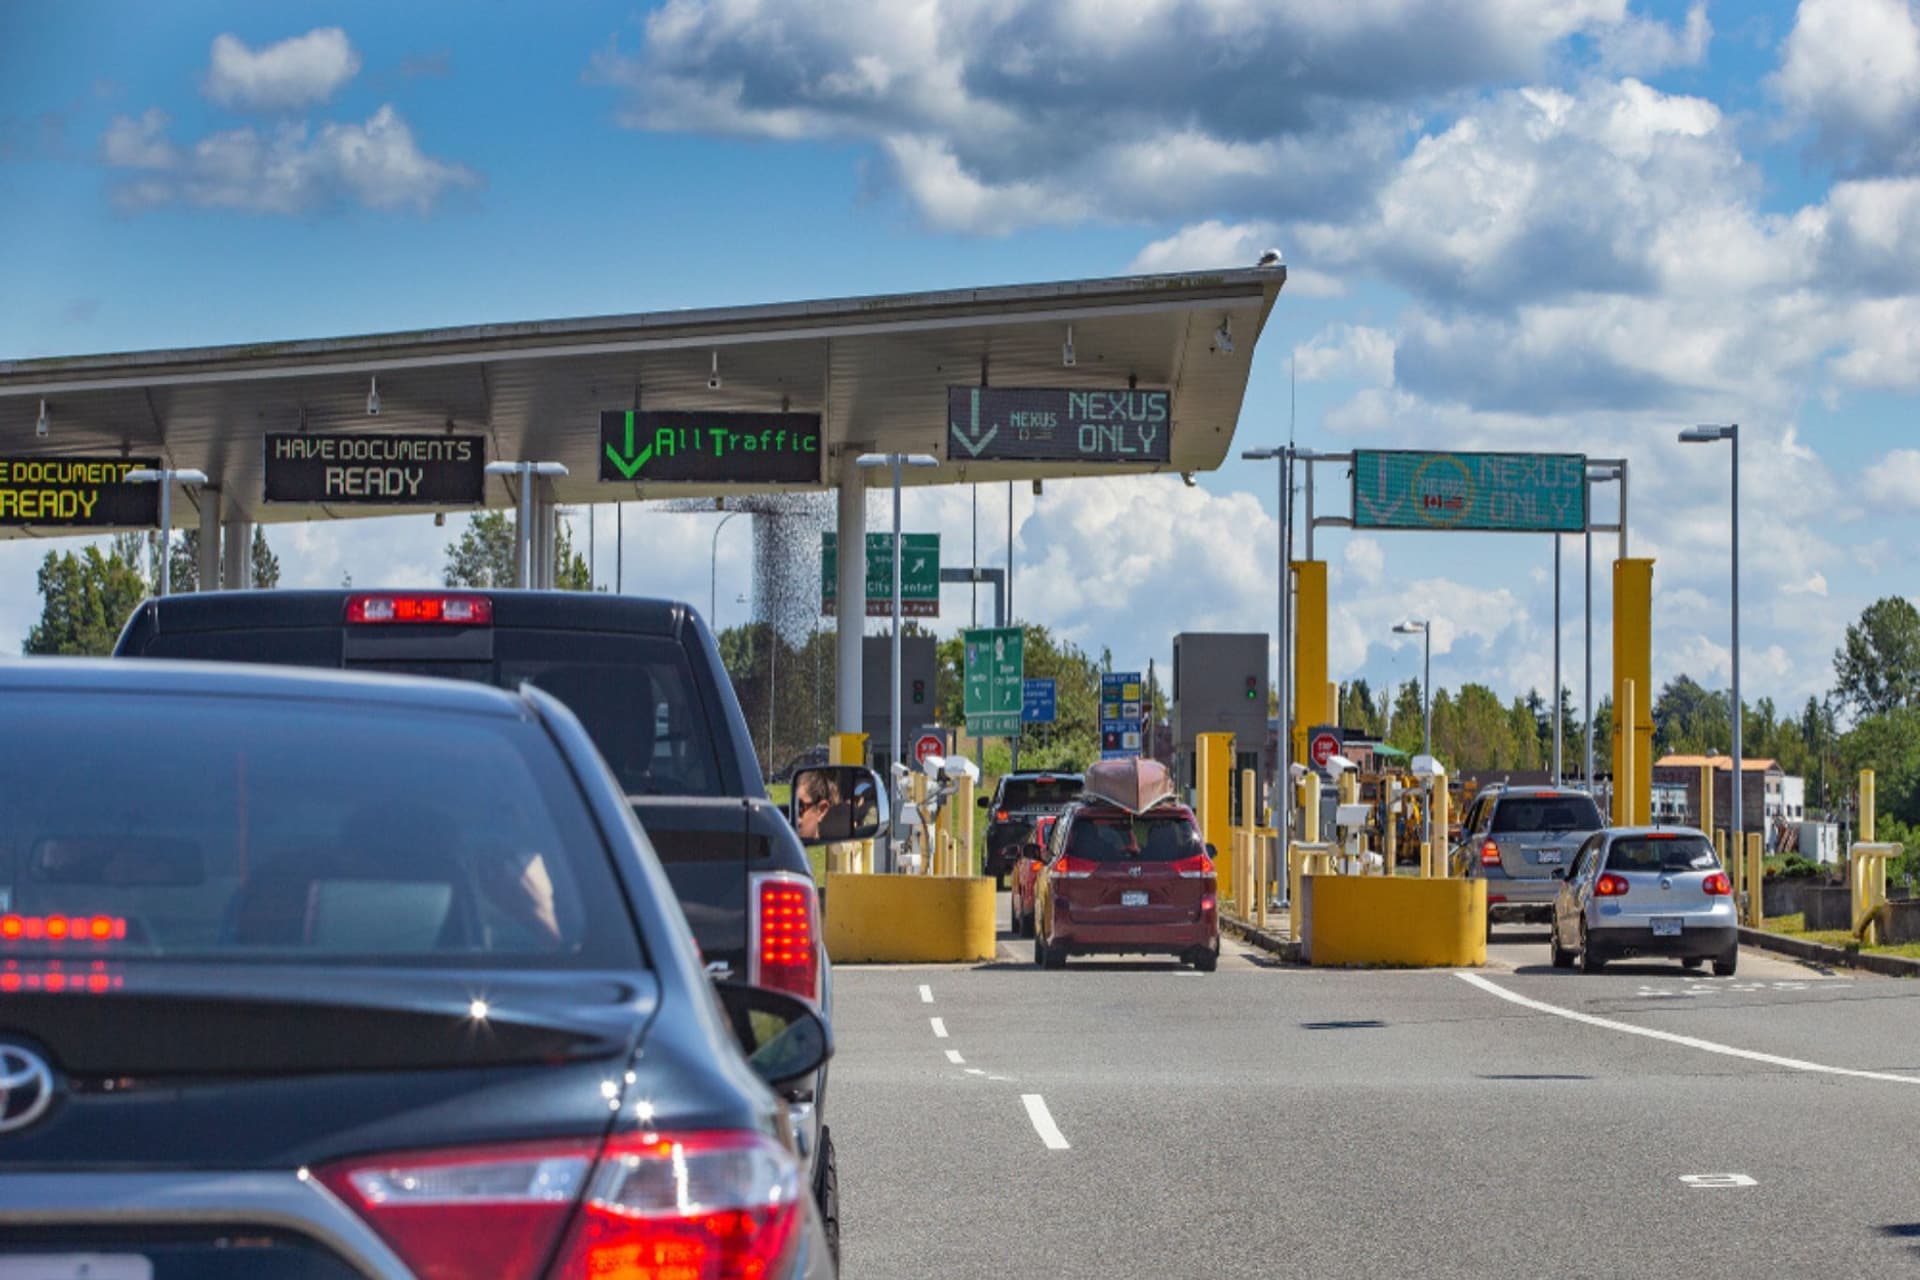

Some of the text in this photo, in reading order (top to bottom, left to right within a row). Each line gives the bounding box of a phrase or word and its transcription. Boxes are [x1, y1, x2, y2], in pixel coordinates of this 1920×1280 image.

[1068, 391, 1168, 422] NEXUS
[275, 438, 471, 461] HAVE DOCUMENTS
[655, 428, 818, 457] All Traffic
[1078, 423, 1157, 453] ONLY
[325, 465, 424, 496] READY
[1480, 455, 1582, 489] NEXUS
[0, 489, 98, 518] READY
[1489, 490, 1571, 522] ONLY
